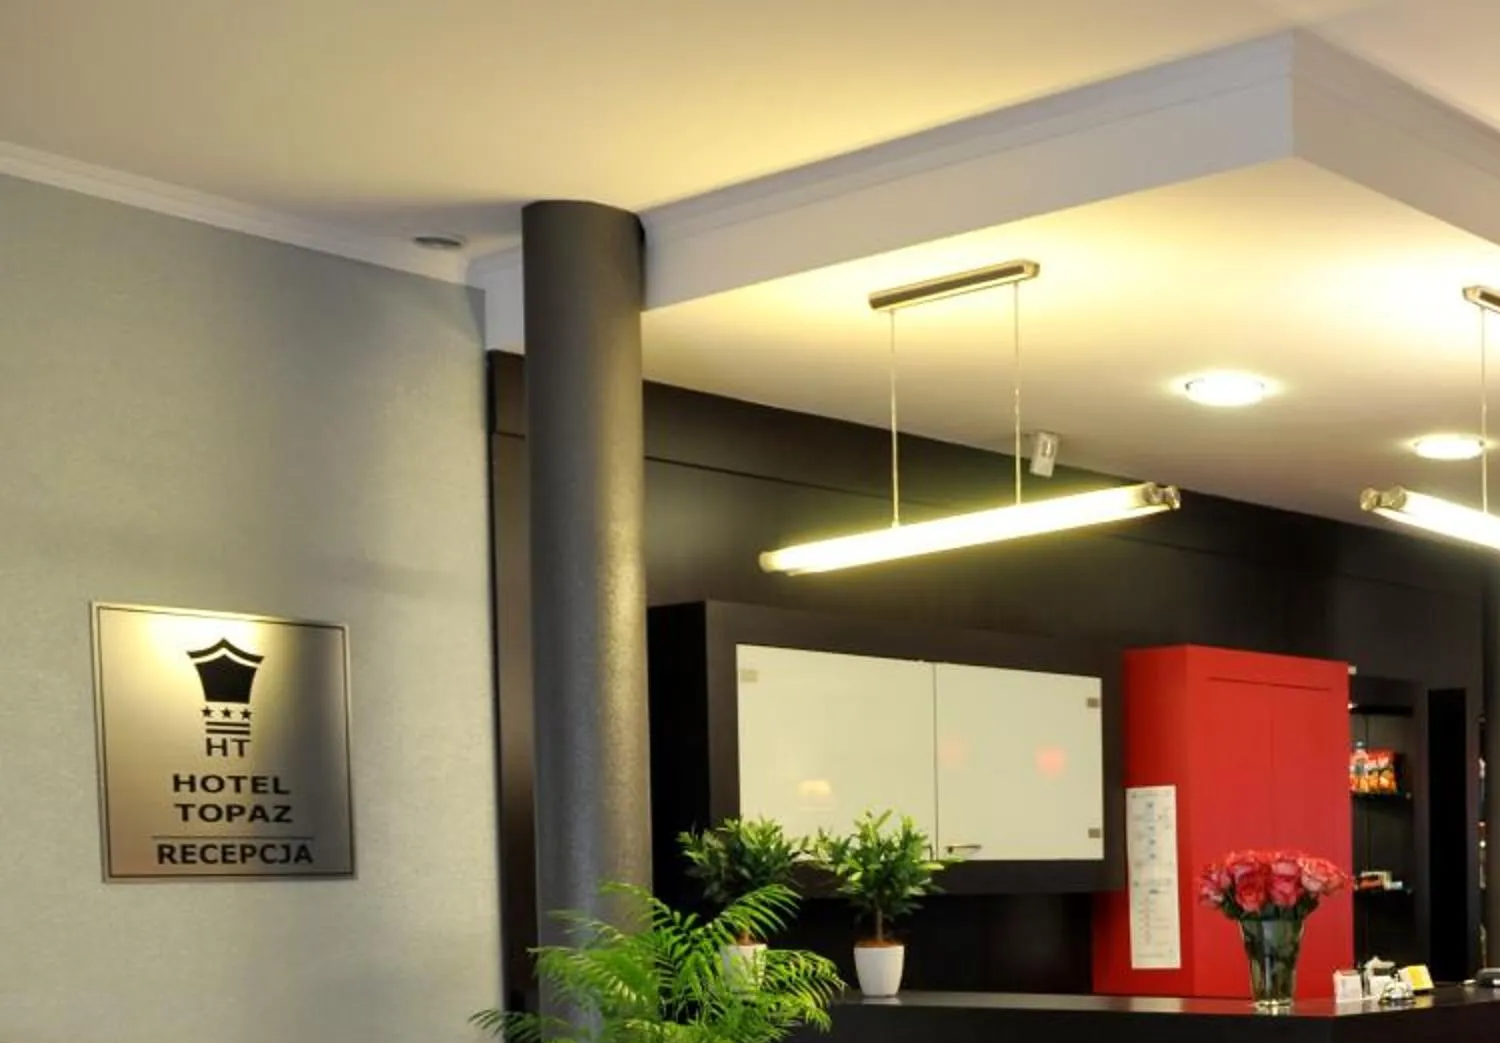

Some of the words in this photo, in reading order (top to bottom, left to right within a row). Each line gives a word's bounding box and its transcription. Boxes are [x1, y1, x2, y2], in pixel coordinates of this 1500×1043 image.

[206, 737, 252, 758] HT
[173, 774, 291, 794] HOTEL
[174, 803, 293, 823] TOPAZ
[157, 843, 313, 864] RECEPCJA
